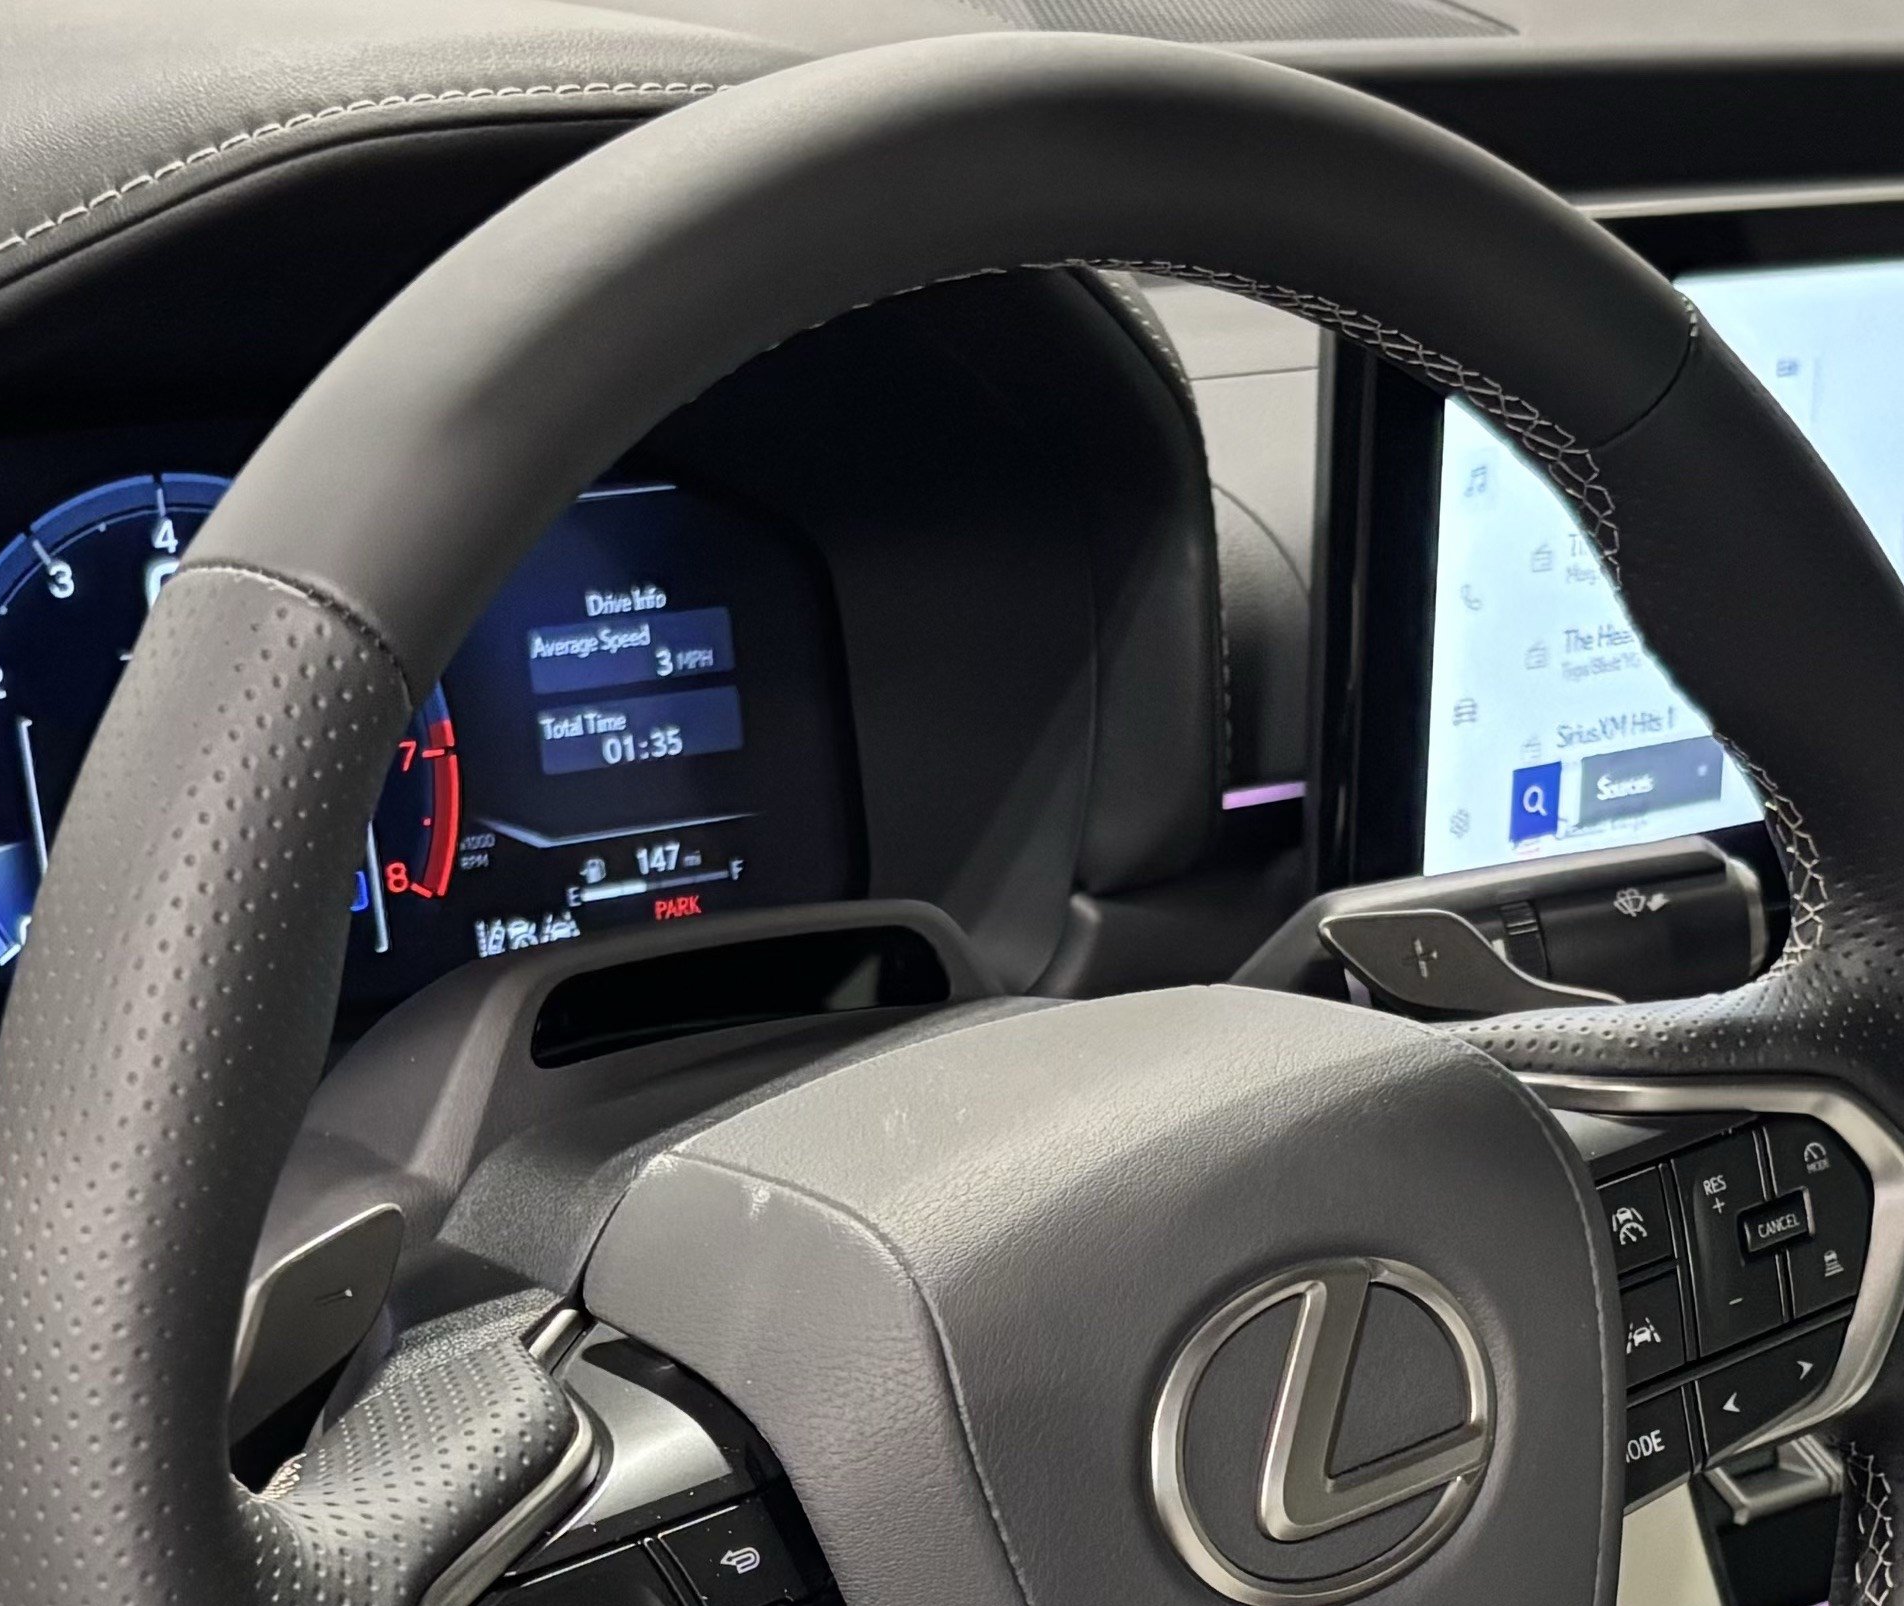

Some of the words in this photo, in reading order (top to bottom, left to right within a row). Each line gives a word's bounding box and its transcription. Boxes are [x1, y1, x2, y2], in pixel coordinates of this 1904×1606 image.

[154, 519, 179, 554] 4
[48, 561, 75, 599] 3
[585, 591, 631, 617] Drive
[631, 585, 667, 611] Info
[530, 630, 600, 661] Average
[600, 623, 651, 652] Speed
[655, 650, 673, 678] 3
[676, 647, 714, 670] MPH
[539, 715, 584, 742] Total
[585, 711, 627, 737] Time
[398, 740, 417, 772] 7
[602, 729, 683, 764] 01:35
[635, 842, 680, 875] 147
[684, 850, 702, 868] mi
[729, 858, 744, 881] F
[385, 861, 408, 893] 8
[566, 886, 583, 907] E
[654, 895, 702, 920] PARK
[1702, 1174, 1727, 1196] RES
[1757, 1212, 1800, 1240] CANCEL
[1626, 1430, 1666, 1463] ODE
